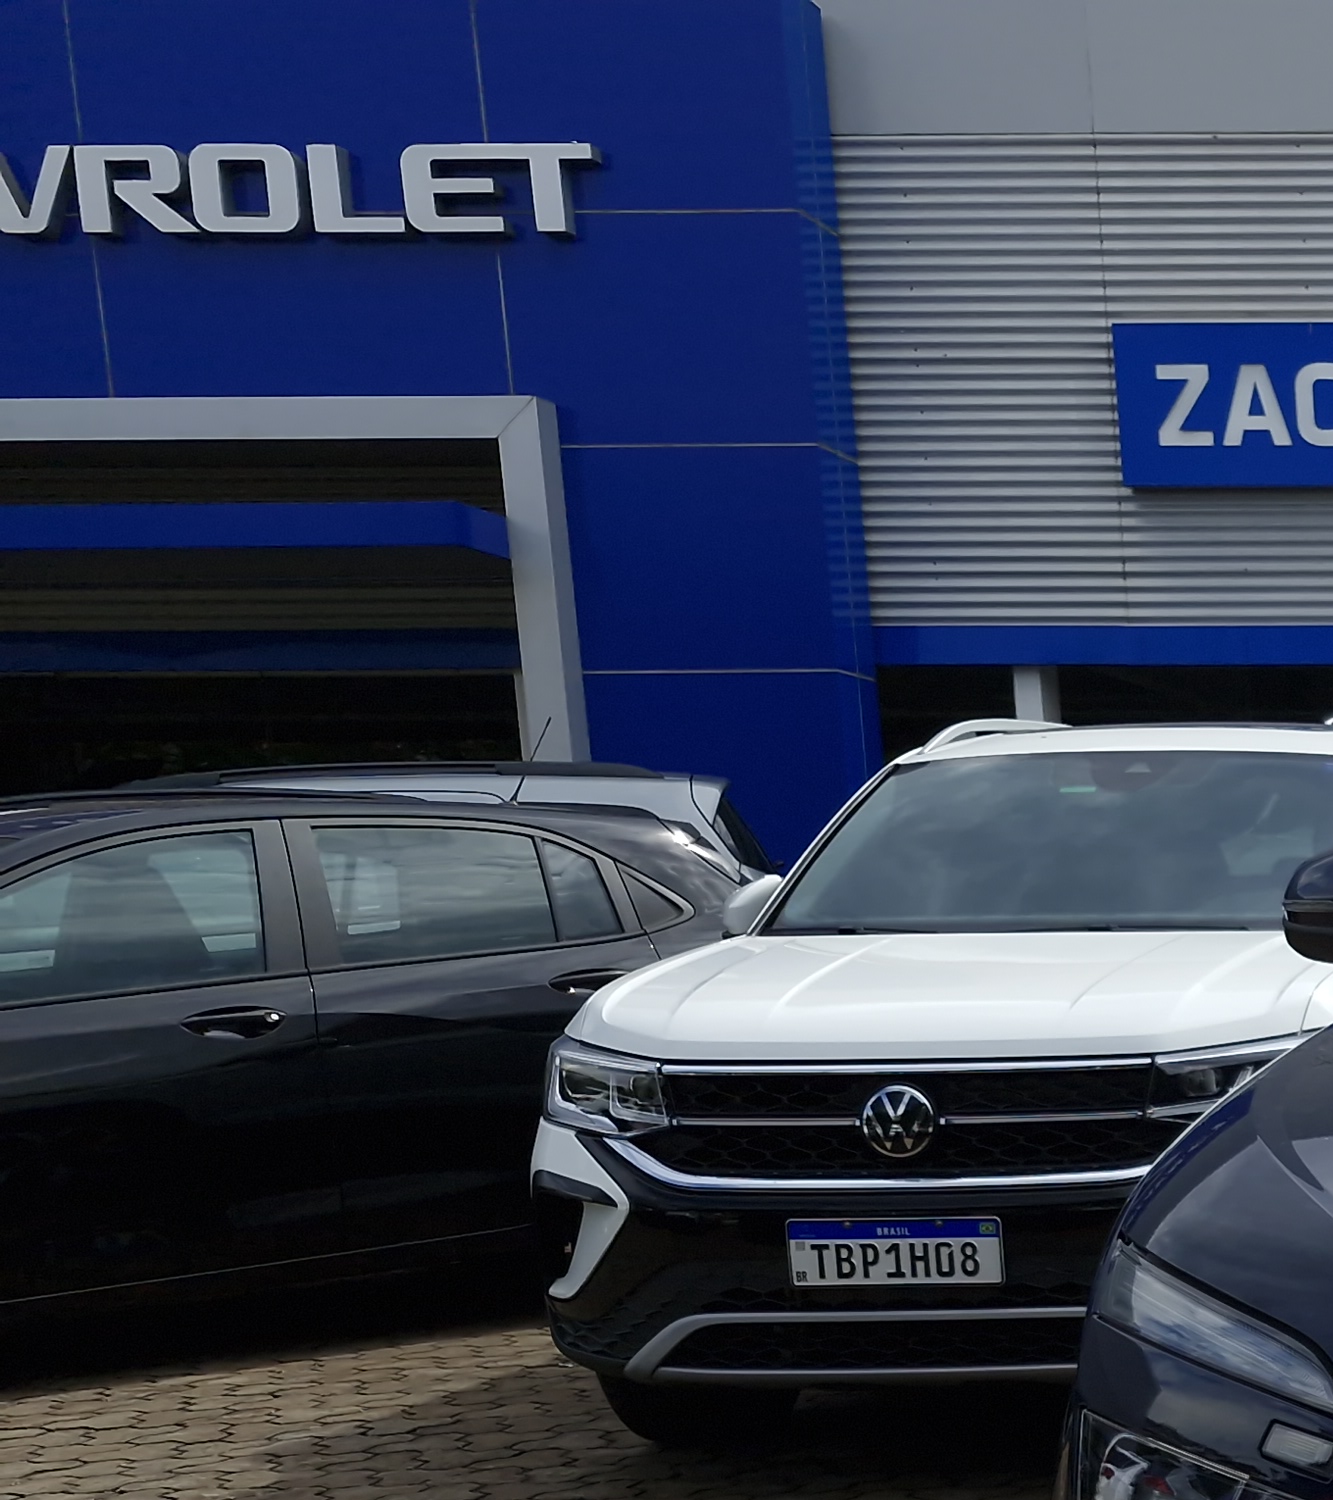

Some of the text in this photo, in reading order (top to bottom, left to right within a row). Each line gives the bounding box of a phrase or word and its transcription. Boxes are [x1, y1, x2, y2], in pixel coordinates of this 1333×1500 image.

[0, 143, 598, 237] VROLET
[876, 1226, 911, 1236] BRASIL
[810, 1241, 980, 1279] TBP1H08
[795, 1271, 808, 1282] BR
